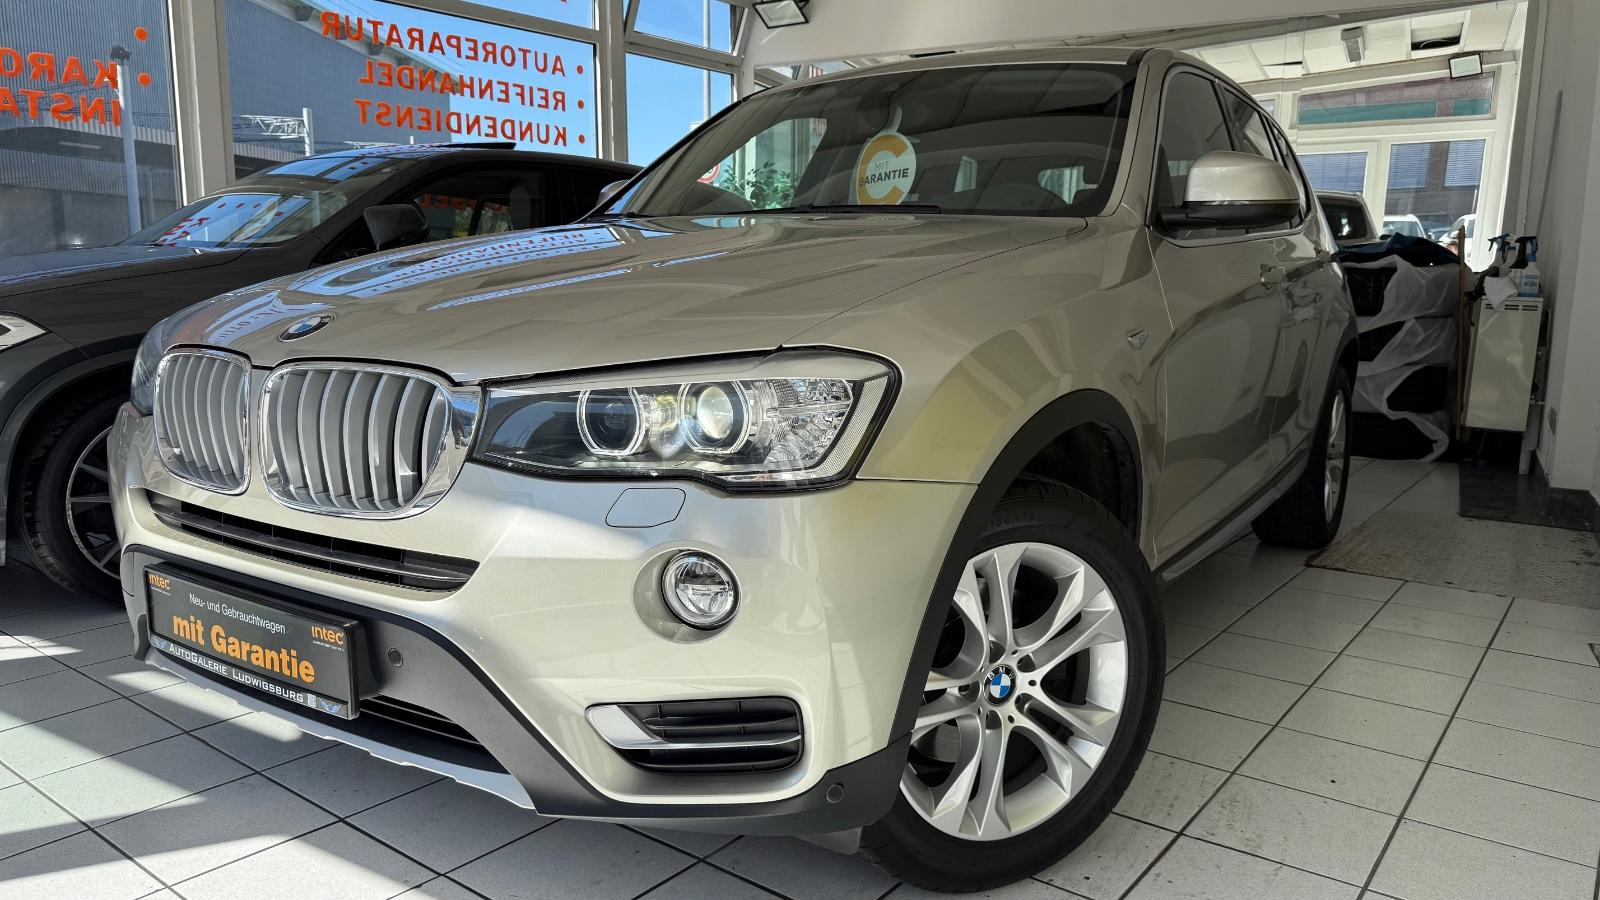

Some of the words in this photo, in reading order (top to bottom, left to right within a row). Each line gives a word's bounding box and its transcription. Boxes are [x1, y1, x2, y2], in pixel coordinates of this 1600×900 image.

[859, 168, 909, 187] GARANTIE
[875, 160, 889, 171] MIT
[189, 592, 206, 608] Neu-
[207, 598, 220, 613] und
[221, 604, 286, 634] Gebrauchtwagen
[173, 614, 205, 646] mit
[210, 624, 315, 683] Garantie
